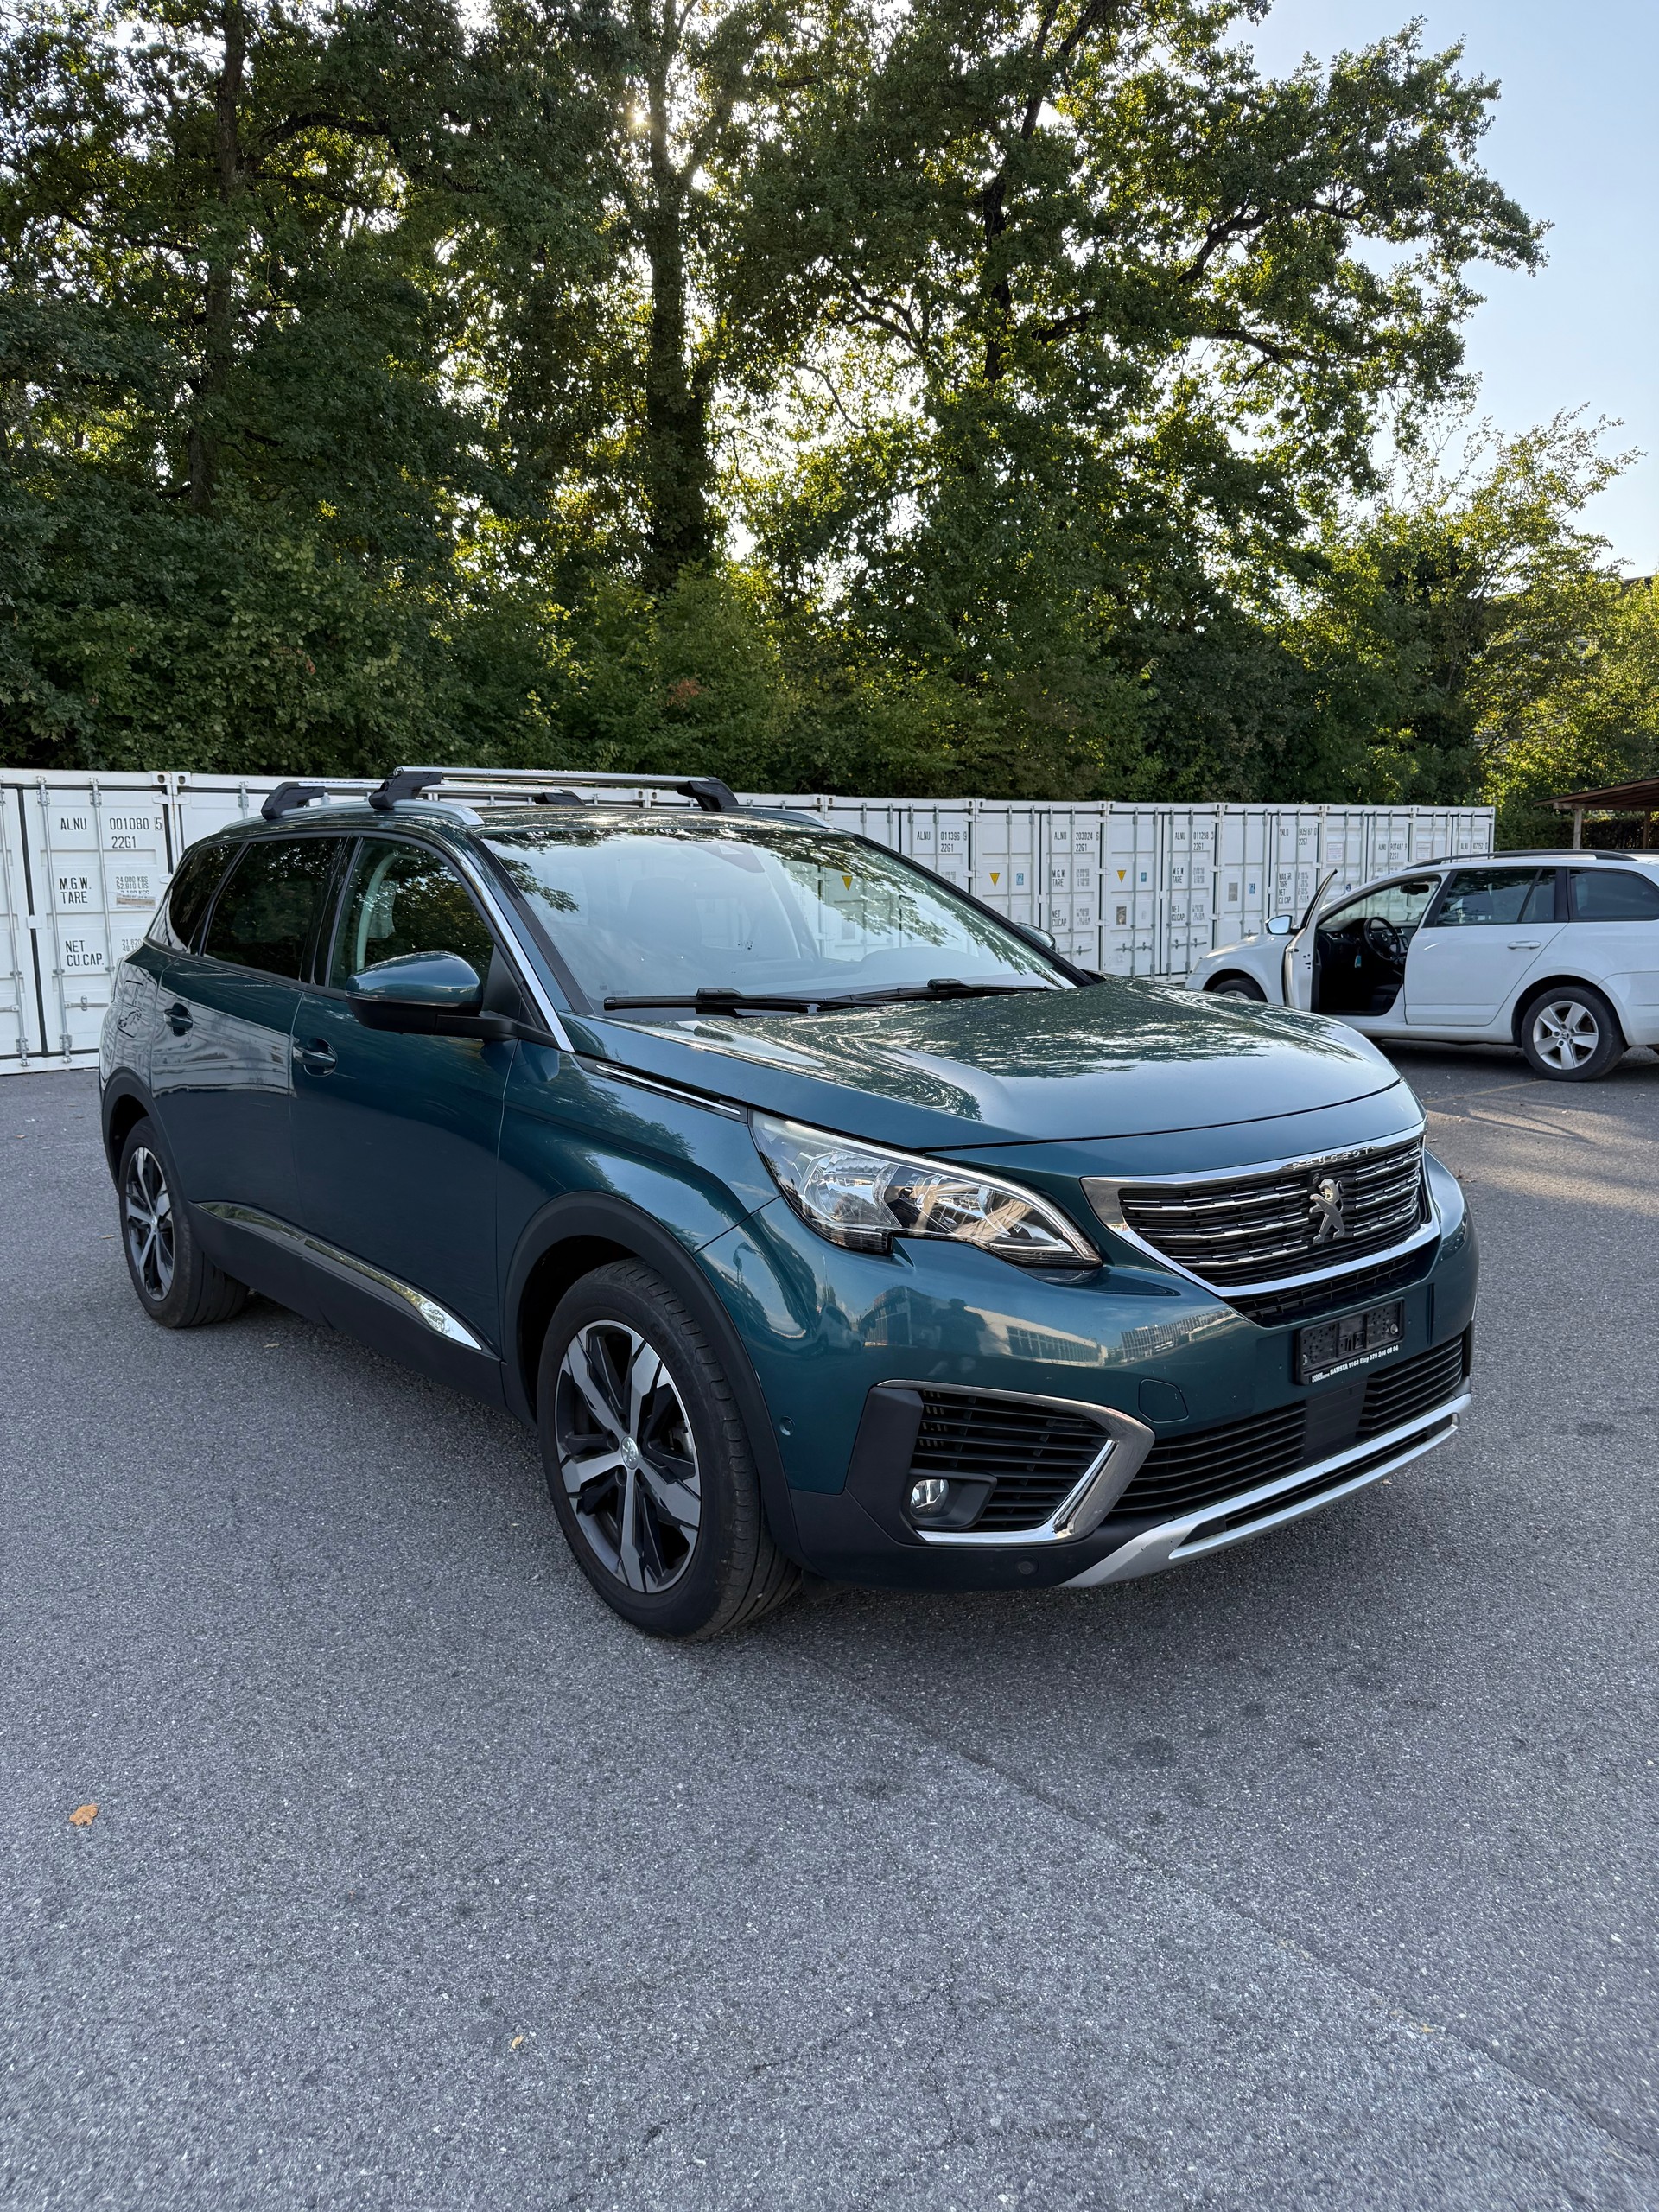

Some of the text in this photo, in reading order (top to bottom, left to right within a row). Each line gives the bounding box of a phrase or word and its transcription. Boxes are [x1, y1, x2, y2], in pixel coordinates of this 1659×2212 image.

[60, 817, 162, 830] ALNU 001080 5
[917, 831, 931, 841] ALNU
[1054, 831, 1067, 841] ALNU
[111, 836, 137, 849] 22G1
[940, 843, 954, 853] 22G1
[1075, 843, 1088, 852] 22G1
[59, 876, 92, 890] M.G.W.
[1052, 879, 1064, 887] TARE
[60, 891, 88, 905] TARE
[1052, 910, 1060, 918] NET
[65, 940, 85, 953] NET
[1292, 1147, 1370, 1171] PEUGEOT
